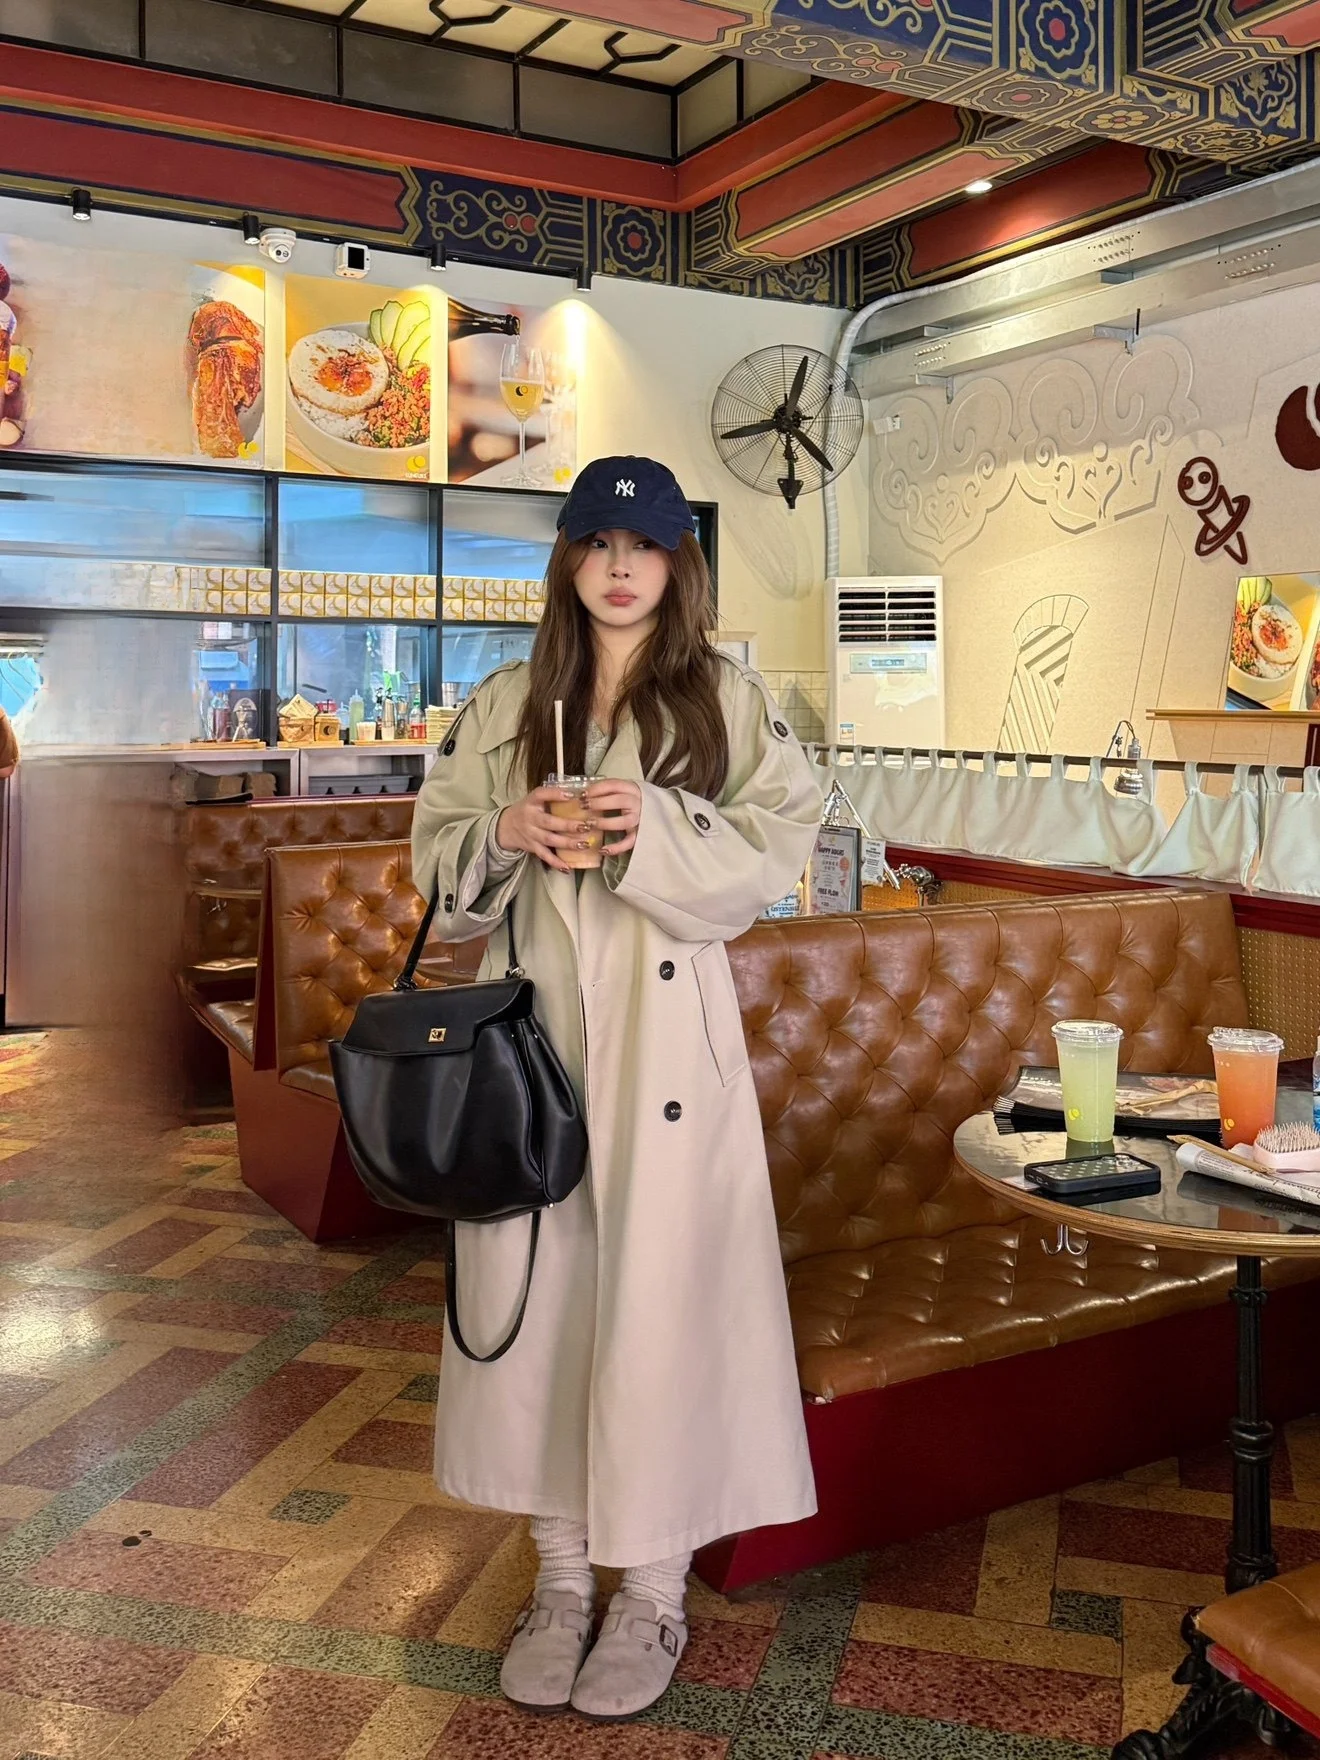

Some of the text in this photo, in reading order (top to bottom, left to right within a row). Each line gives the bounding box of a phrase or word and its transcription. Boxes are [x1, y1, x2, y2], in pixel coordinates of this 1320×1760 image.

[614, 478, 636, 497] NY
[818, 846, 830, 854] HAPPY
[817, 887, 839, 897] FREE FLOW
